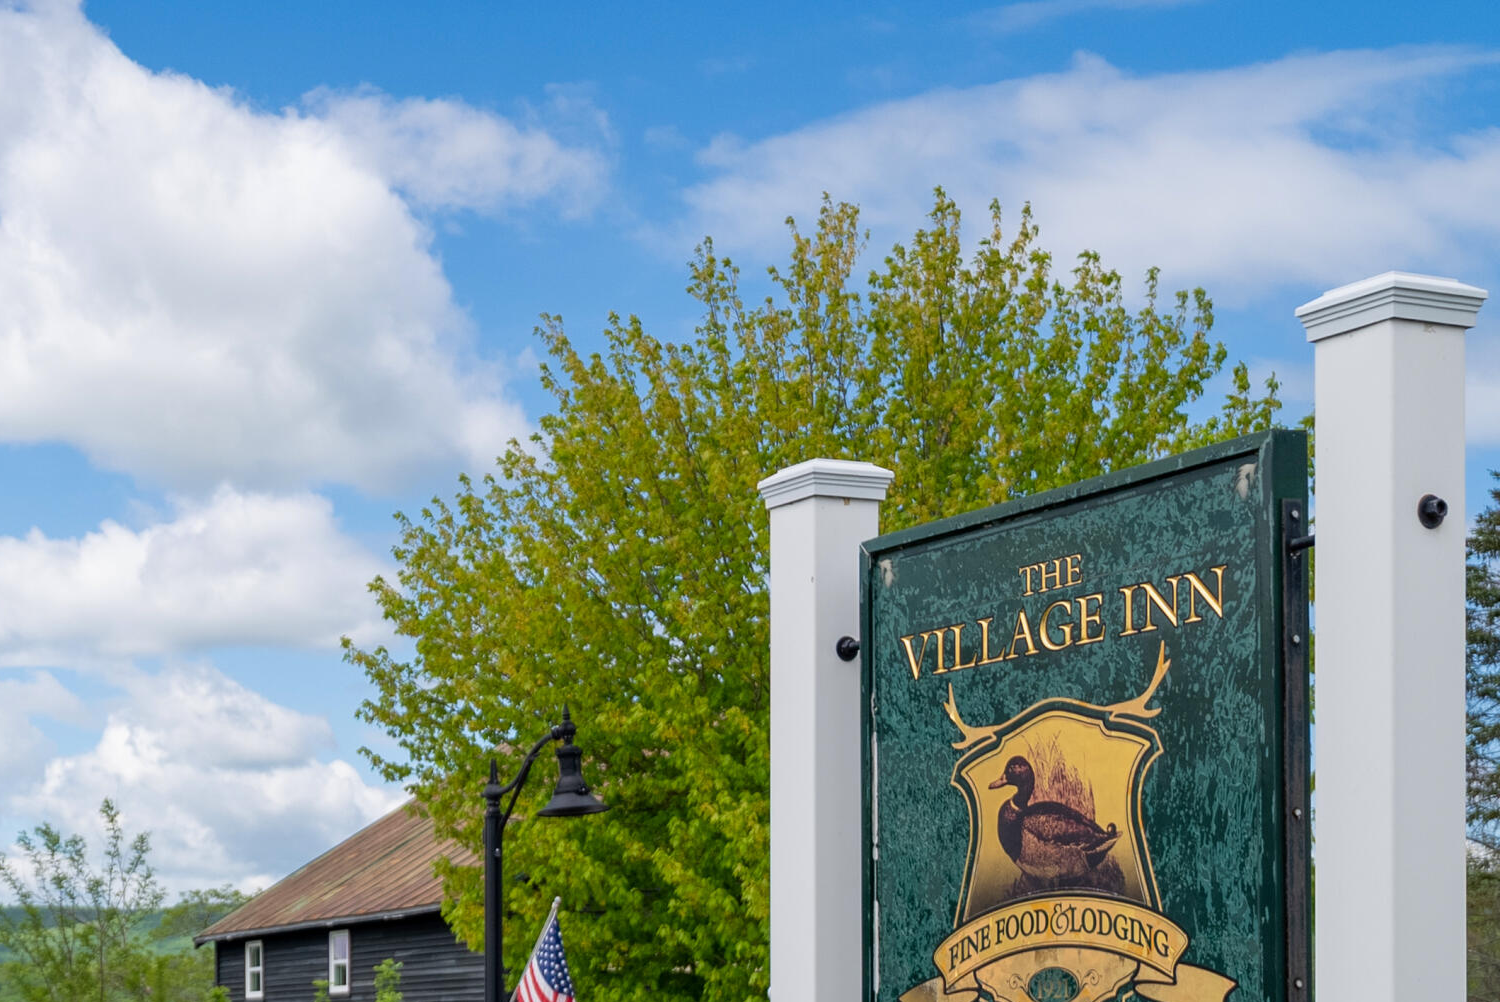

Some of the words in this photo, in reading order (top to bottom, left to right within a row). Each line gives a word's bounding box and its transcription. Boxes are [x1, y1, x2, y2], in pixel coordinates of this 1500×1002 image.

[1018, 553, 1084, 597] THE
[900, 594, 1106, 680] VILLAGE
[1118, 564, 1228, 638] INN
[948, 925, 991, 972] FINE
[1036, 977, 1070, 1000] 1921
